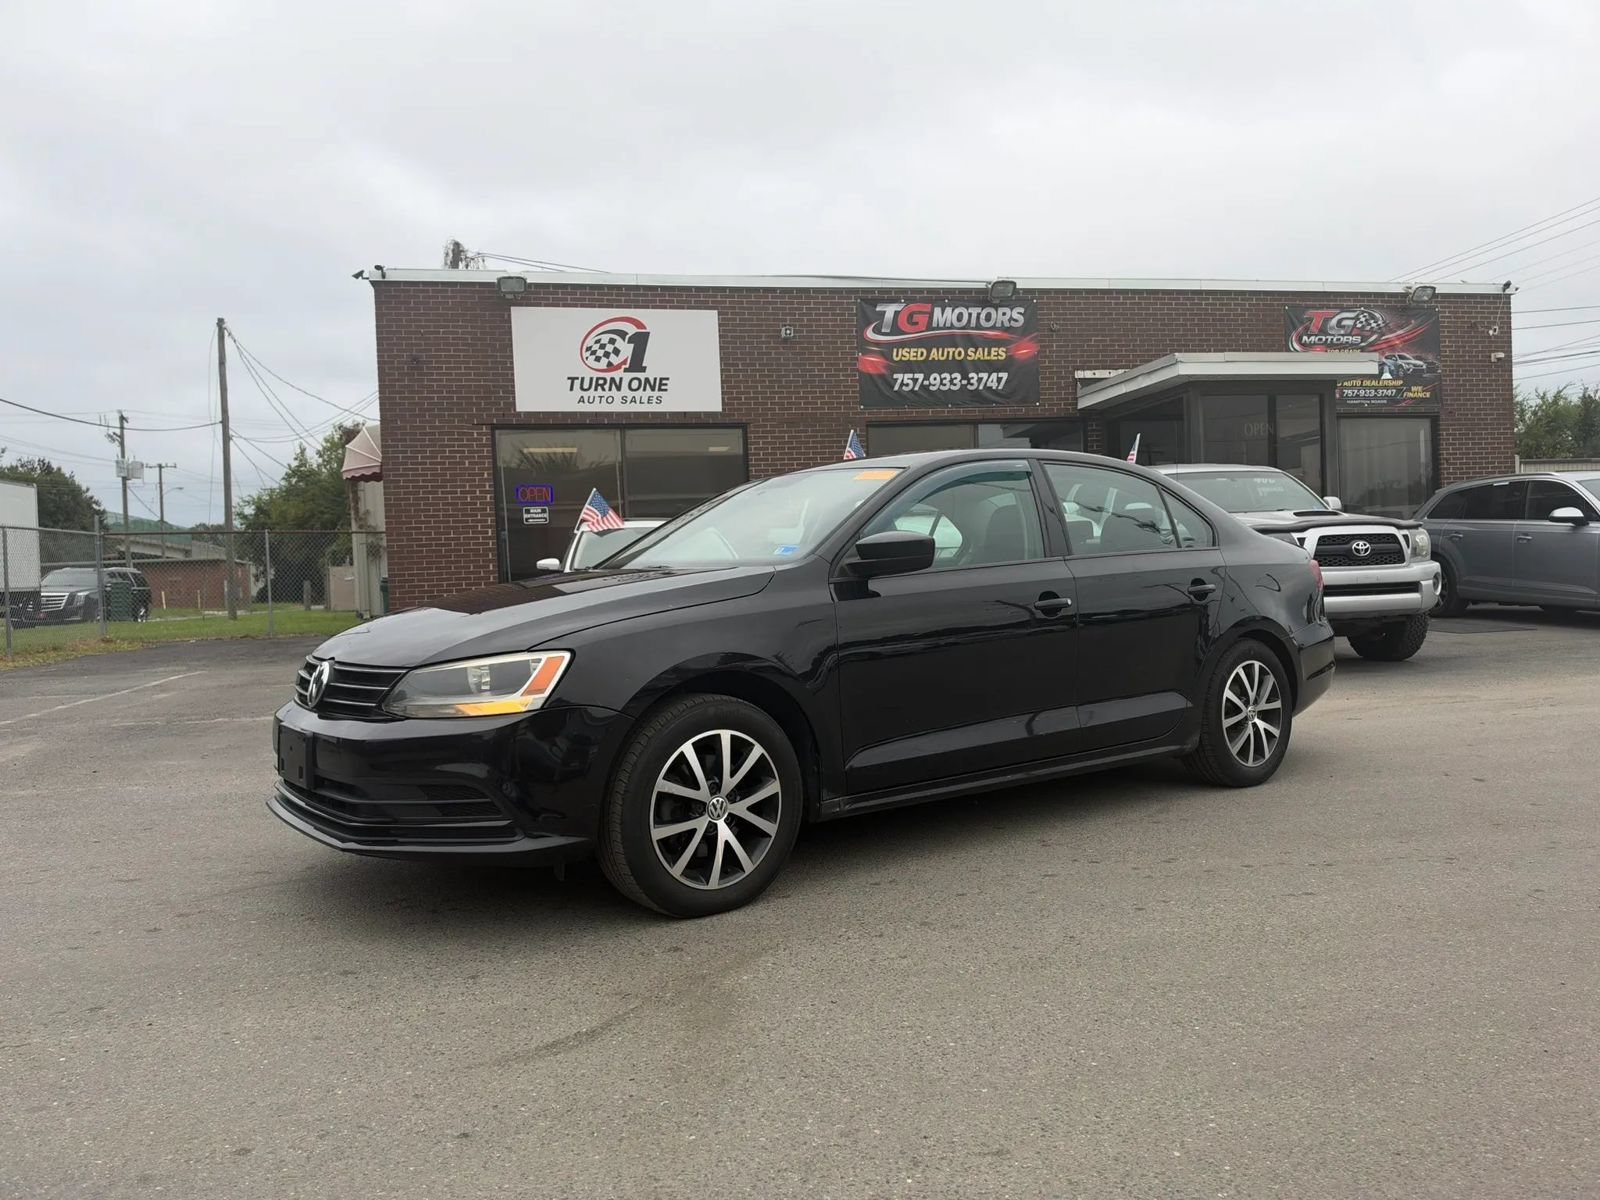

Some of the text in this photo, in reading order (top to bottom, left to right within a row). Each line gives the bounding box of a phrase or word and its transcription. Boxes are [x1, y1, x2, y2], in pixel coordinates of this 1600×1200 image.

[875, 303, 1025, 333] TG MOTORS
[1303, 309, 1360, 335] TG
[1301, 335, 1362, 344] MOTORS
[892, 347, 1007, 361] USED AUTO SALES
[567, 376, 670, 392] TURN ONE
[892, 372, 1008, 391] 757-933-3747
[1342, 379, 1361, 387] AUTO
[1362, 379, 1404, 387] DEALERSHIP
[1342, 389, 1397, 397] 757-933-3747
[1403, 391, 1431, 399] FINANCE
[577, 395, 663, 405] AUTO SALES
[1244, 423, 1274, 436] OPEN
[520, 487, 551, 501] OPEN
